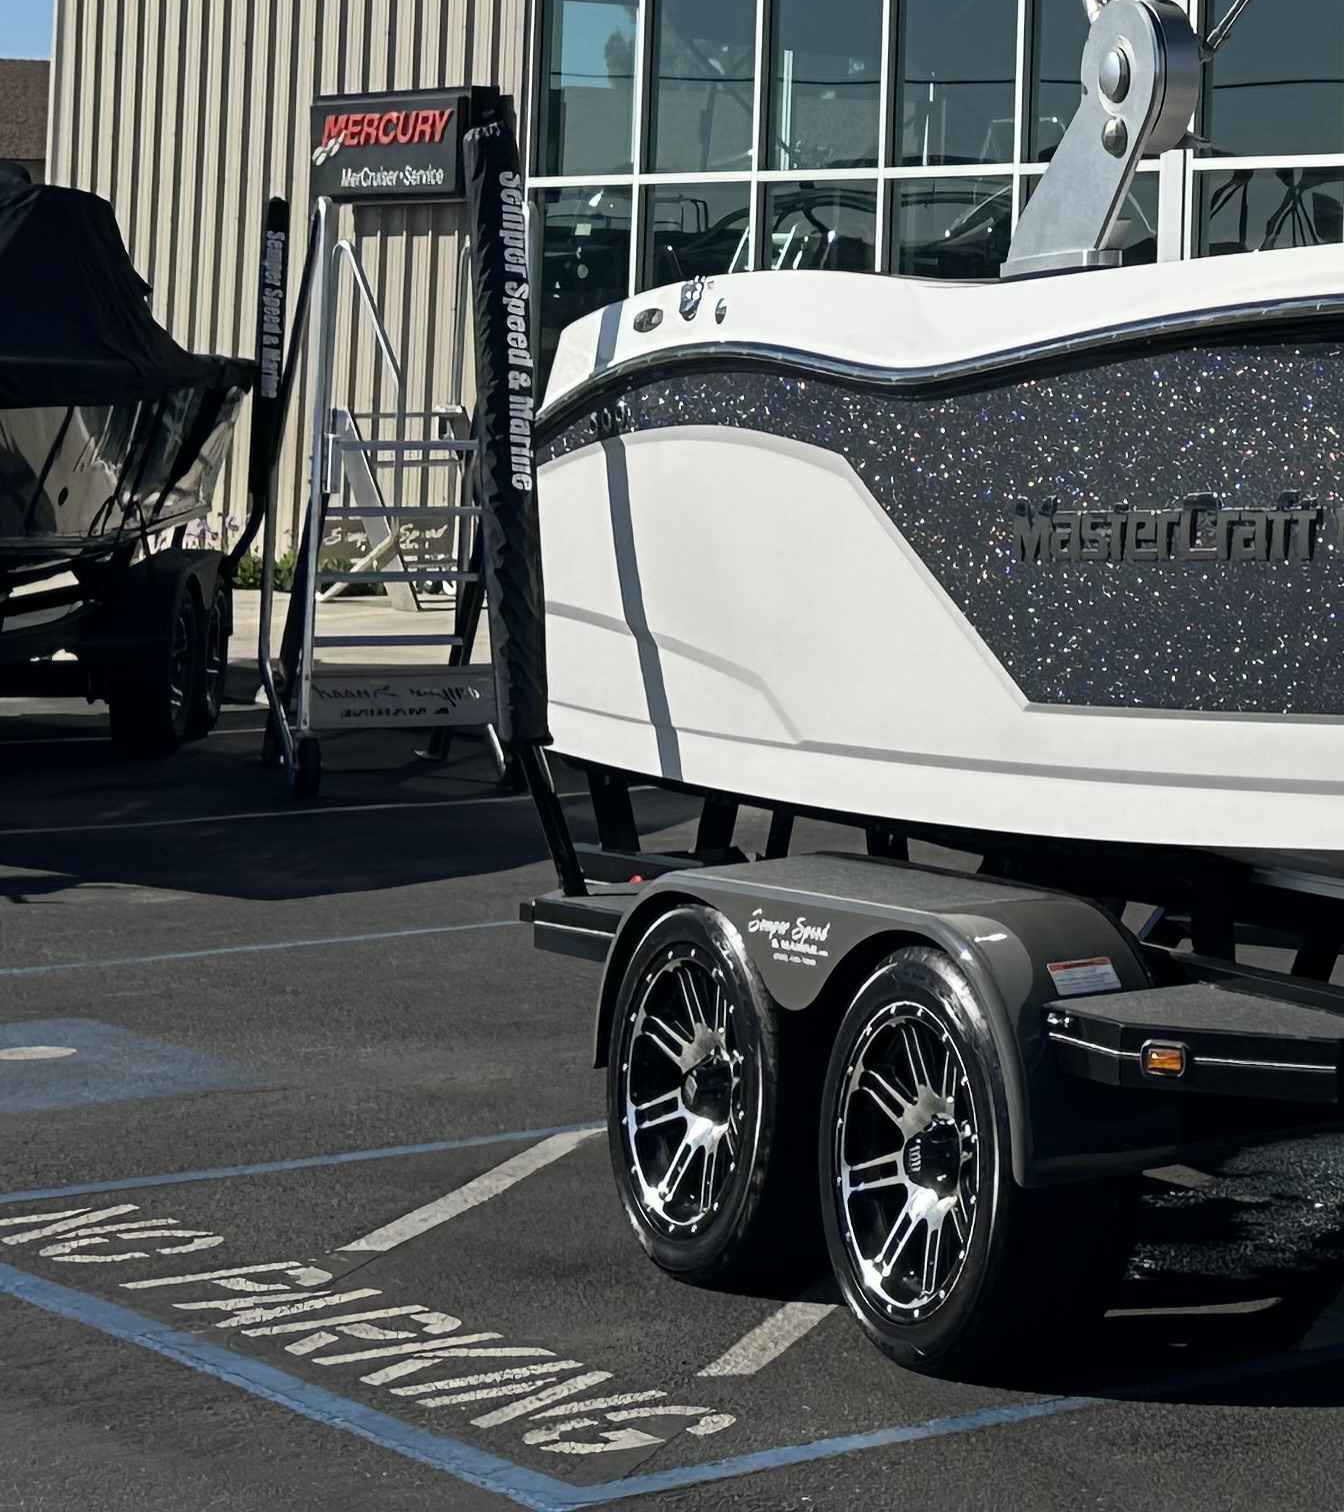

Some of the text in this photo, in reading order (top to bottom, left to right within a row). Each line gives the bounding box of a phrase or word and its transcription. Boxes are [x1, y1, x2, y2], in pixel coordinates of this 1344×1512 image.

[322, 107, 455, 149] MERCURY
[263, 287, 284, 334] Speed
[499, 170, 534, 492] Semper Speed & Marine
[1014, 491, 1324, 564] MasterCraft
[0, 1203, 738, 1456] NO PARKING
